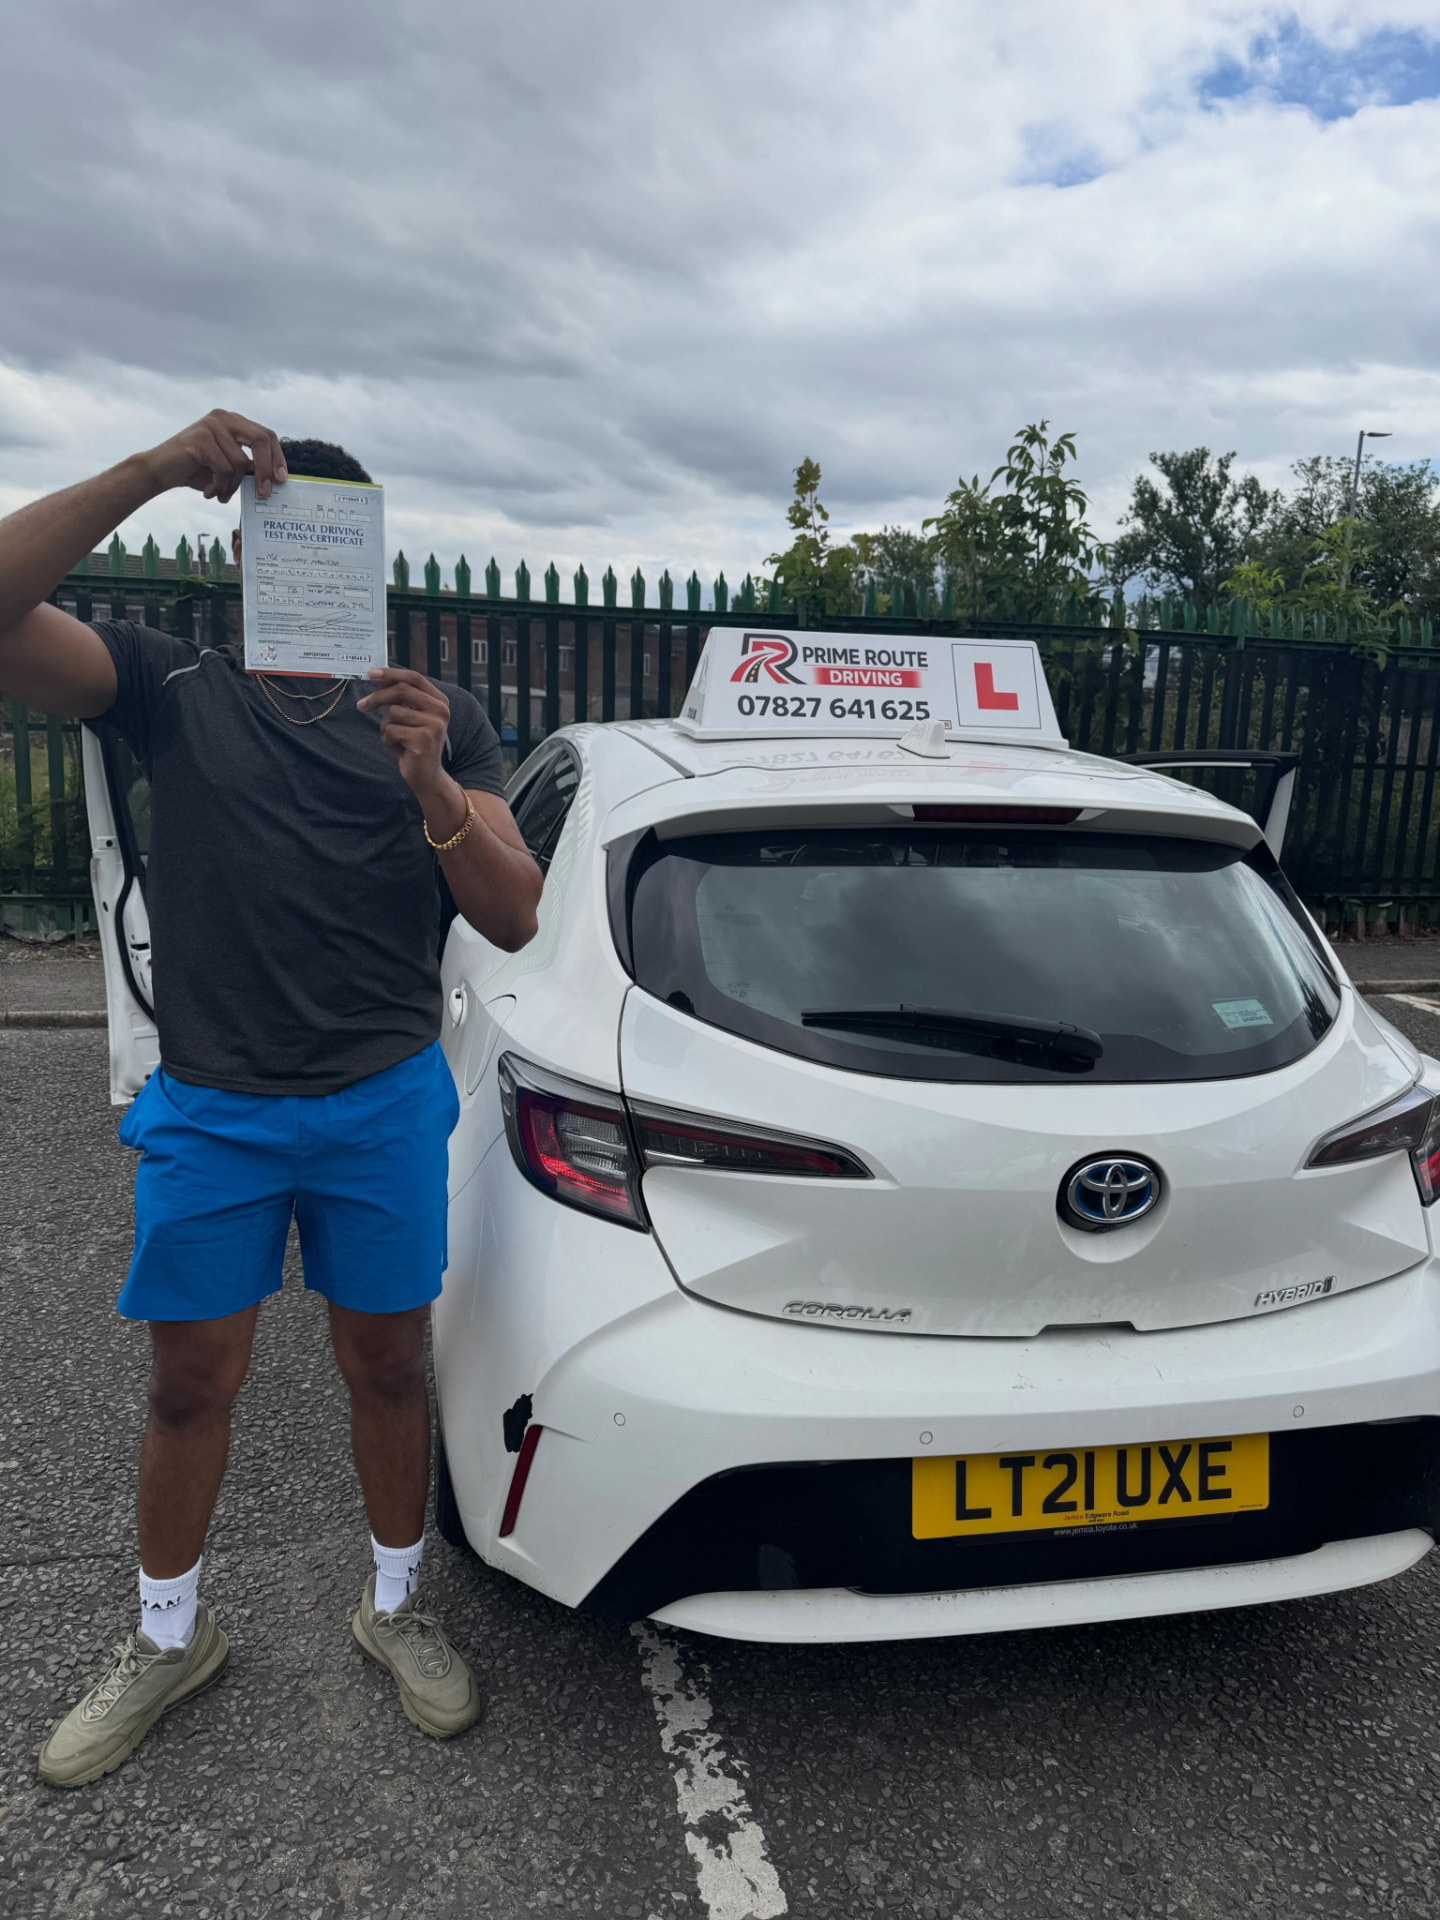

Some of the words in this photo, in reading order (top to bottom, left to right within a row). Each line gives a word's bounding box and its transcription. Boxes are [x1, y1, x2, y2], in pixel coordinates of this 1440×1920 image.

[263, 520, 316, 533] PRACTICAL
[320, 525, 364, 537] DRIVING
[264, 530, 284, 539] TEST
[287, 531, 308, 541] PASS
[310, 534, 364, 546] CERTIFICATE
[802, 646, 860, 665] PRIME
[865, 649, 928, 668] ROUTE
[829, 670, 903, 687] DRIVING
[973, 662, 1019, 711] L
[737, 695, 821, 718] 07827
[1254, 1280, 1324, 1307] HYBRID
[782, 1300, 912, 1322] COROLLA
[955, 1451, 1095, 1521] LT21
[1116, 1440, 1233, 1508] UXE
[1085, 1511, 1112, 1519] Edgware
[1053, 1522, 1138, 1536] www.jemca.toyota.co.uk
